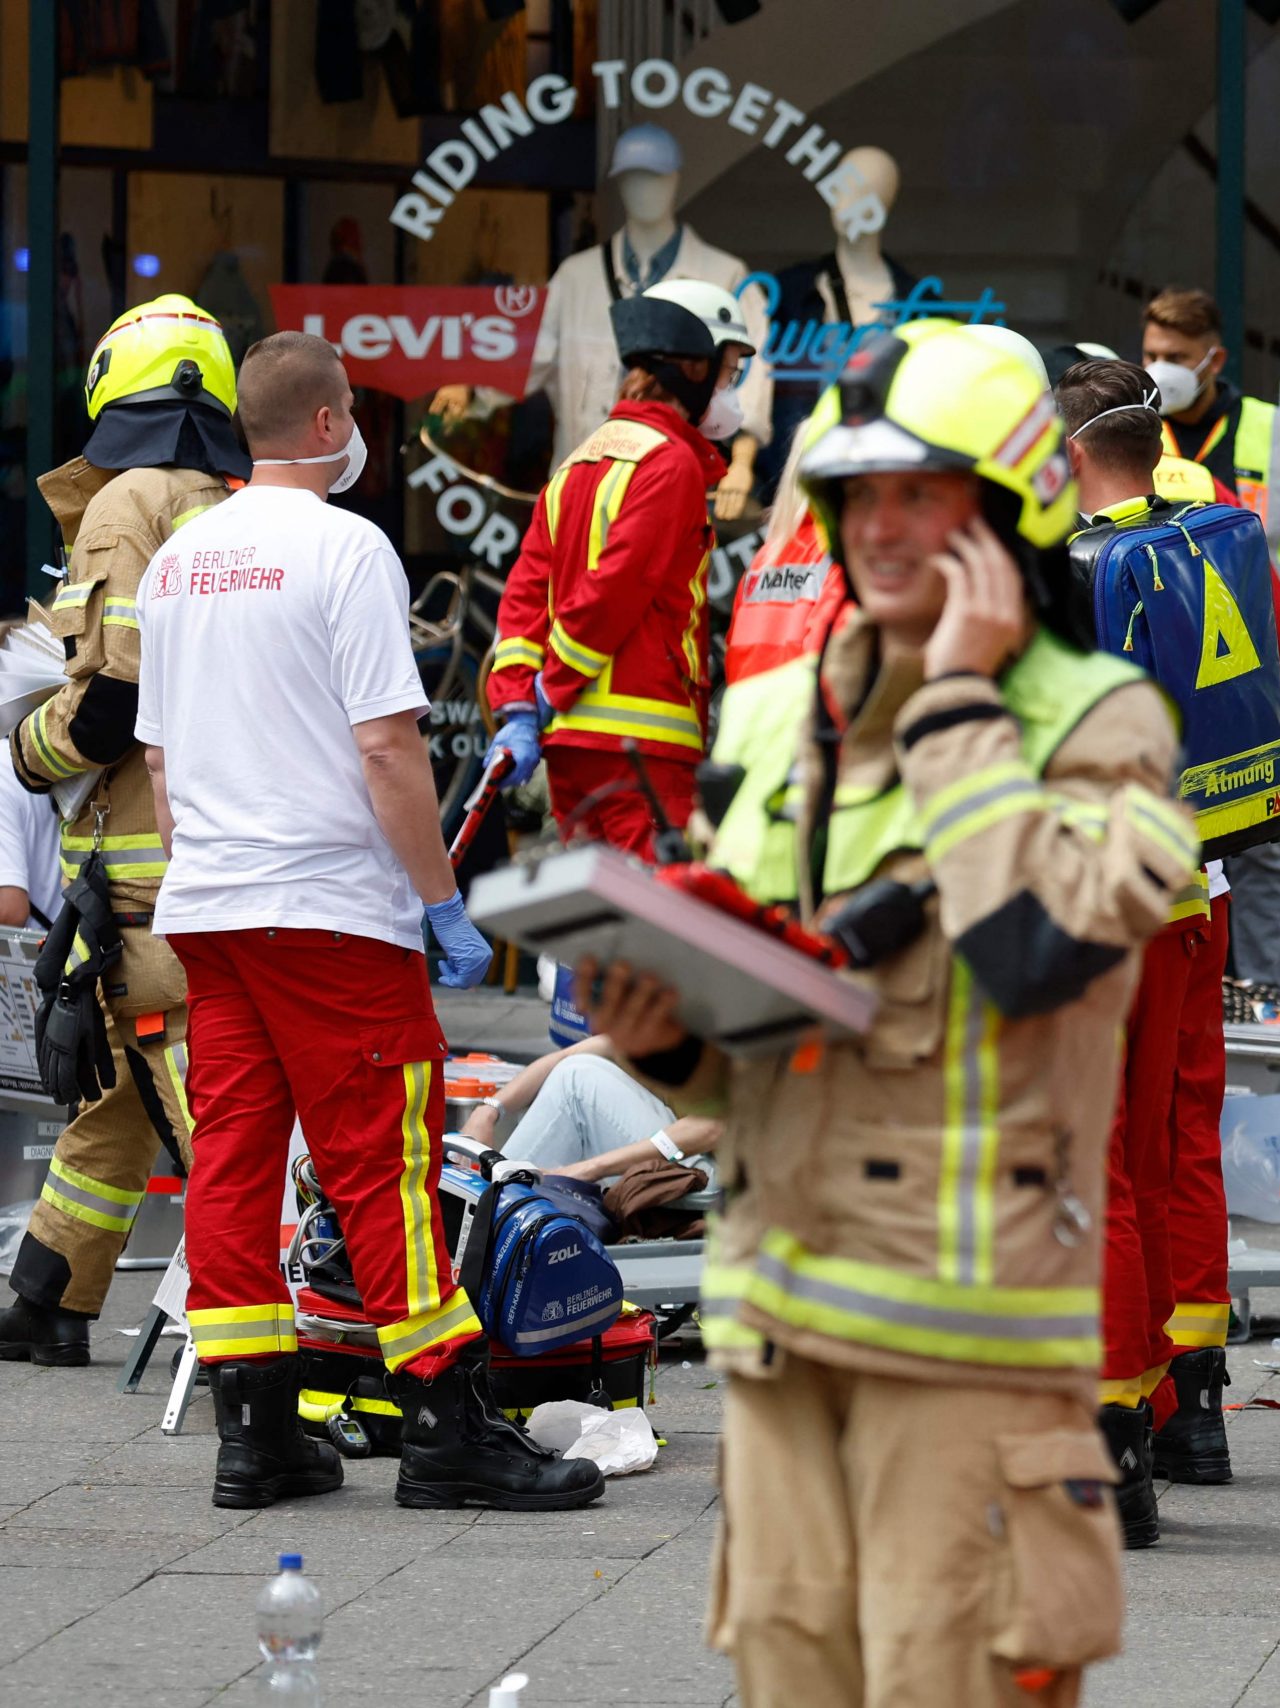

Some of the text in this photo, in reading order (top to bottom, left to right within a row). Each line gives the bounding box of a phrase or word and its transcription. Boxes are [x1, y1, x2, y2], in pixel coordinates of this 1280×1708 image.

[390, 58, 887, 243] RIDING TOGETHER
[407, 454, 520, 568] FOR
[192, 546, 256, 569] BERLINER
[189, 567, 285, 596] FEUERWEHR
[1204, 760, 1276, 798] Atmung
[547, 1244, 582, 1265] ZOLL
[566, 1285, 600, 1305] BERLINER
[566, 1287, 613, 1317] FEUERWEHR
